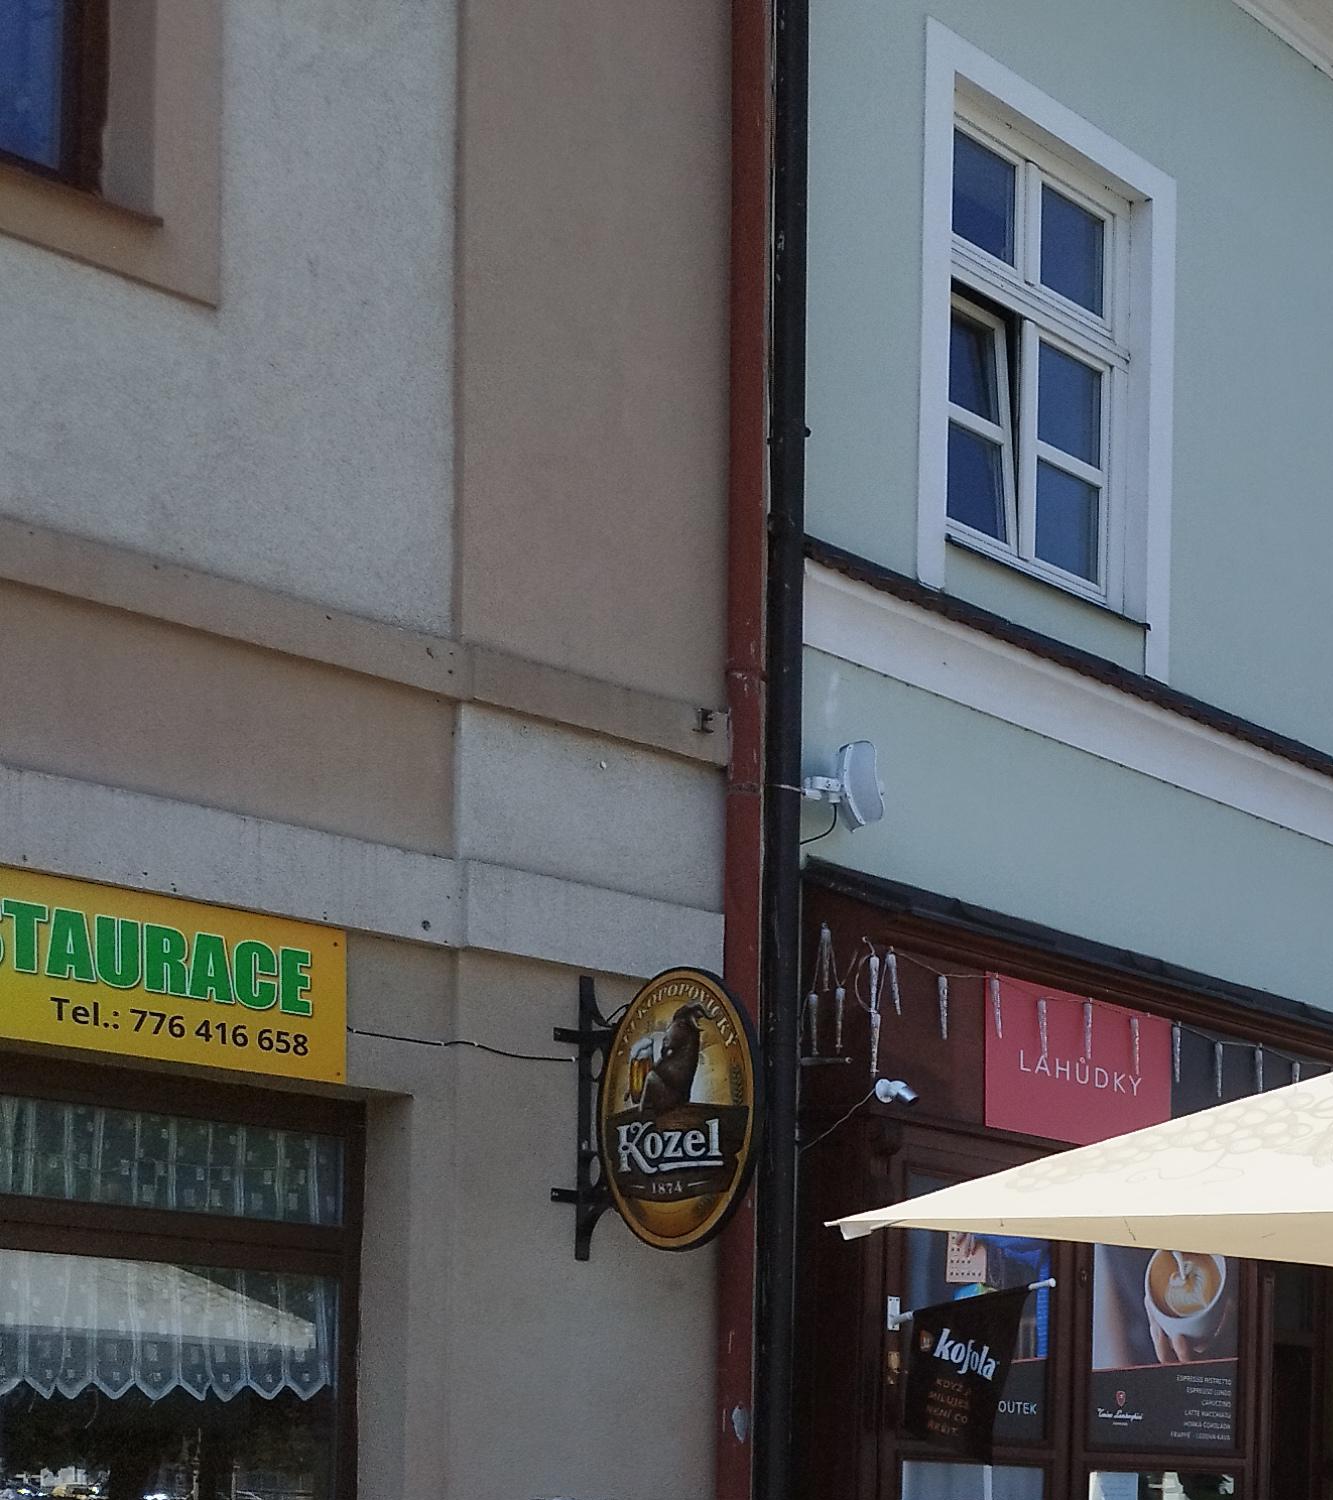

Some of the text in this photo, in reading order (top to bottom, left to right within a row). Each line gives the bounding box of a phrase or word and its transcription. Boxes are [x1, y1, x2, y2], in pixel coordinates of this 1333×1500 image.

[0, 897, 313, 1018] TAURACE
[50, 997, 310, 1057] Tel.: 776 416 658
[1018, 1049, 1142, 1097] LAHŮDKY
[616, 1119, 728, 1175] Kozel
[650, 1181, 683, 1195] 1874
